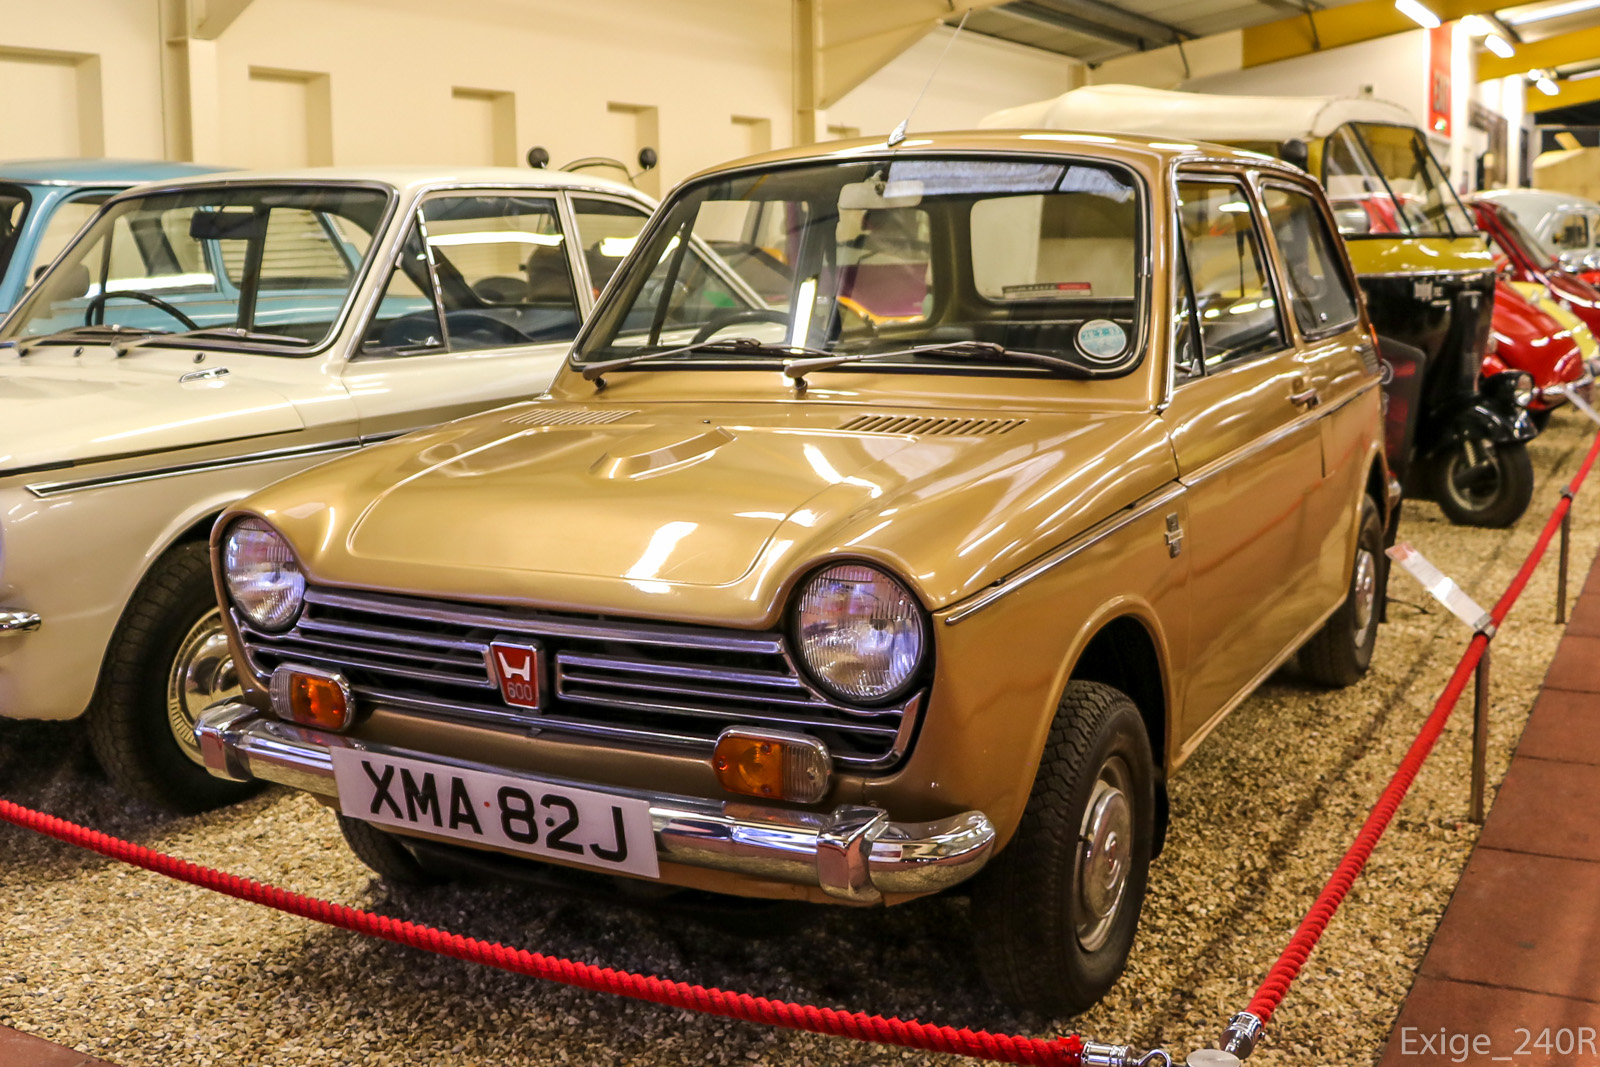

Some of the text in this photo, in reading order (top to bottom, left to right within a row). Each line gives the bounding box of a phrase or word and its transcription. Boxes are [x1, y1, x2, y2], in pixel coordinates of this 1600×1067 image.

[507, 681, 533, 701] 600
[361, 760, 628, 863] XMA 82J
